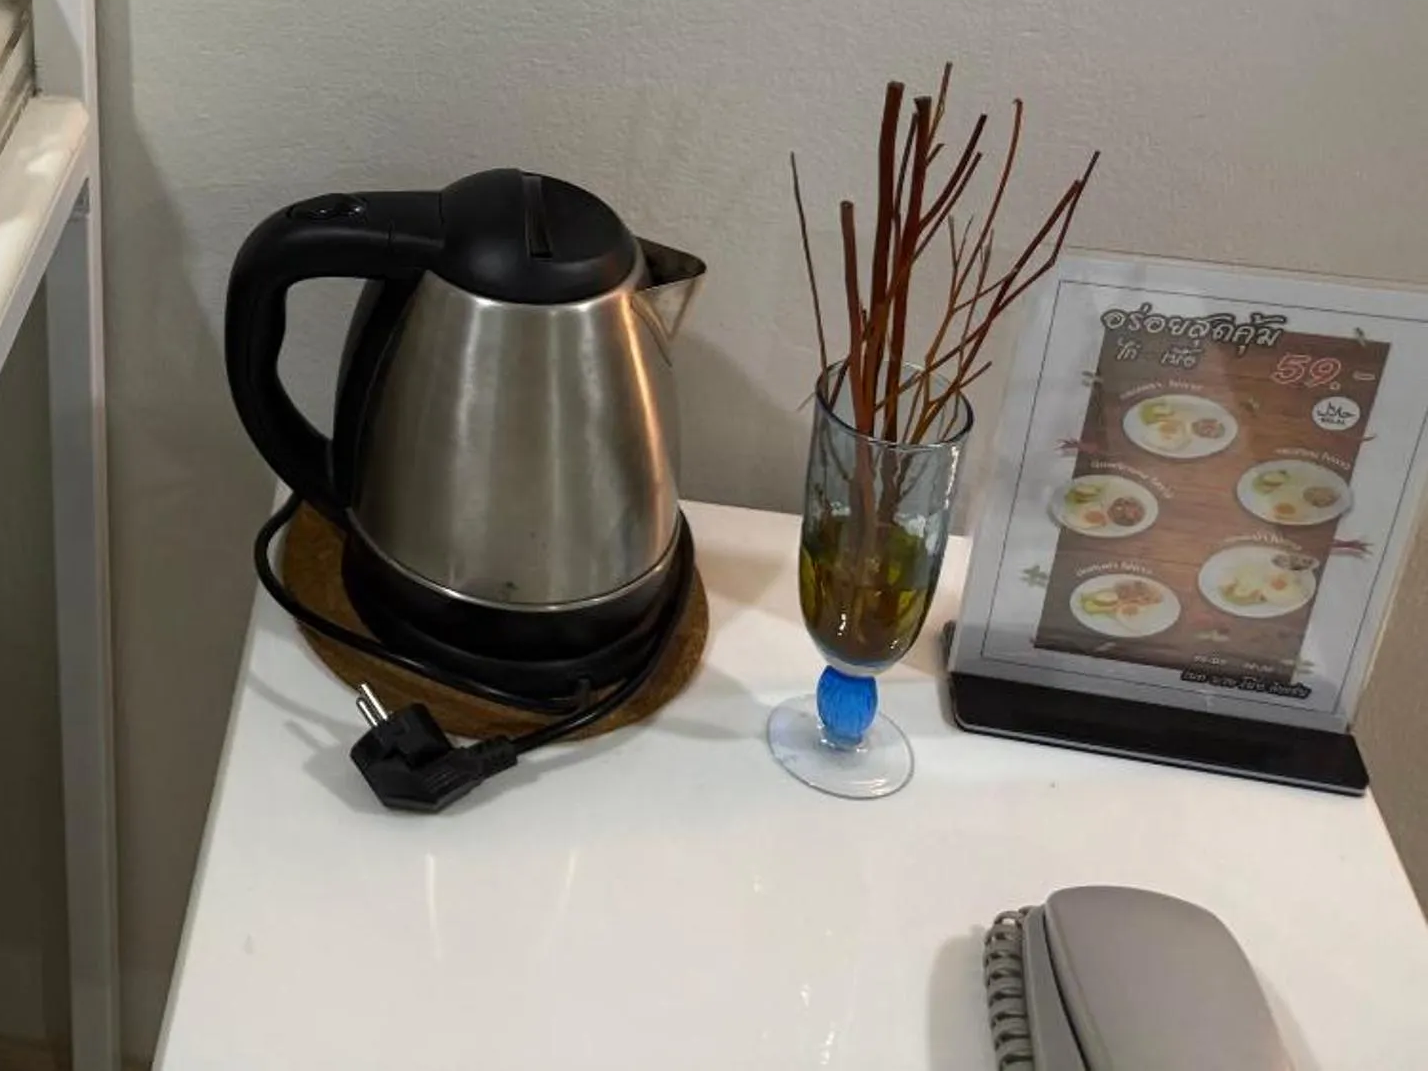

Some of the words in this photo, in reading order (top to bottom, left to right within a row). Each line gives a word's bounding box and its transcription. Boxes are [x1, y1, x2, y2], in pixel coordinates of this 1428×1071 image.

[1101, 303, 1287, 356] อร่อยสุดคุ้ม
